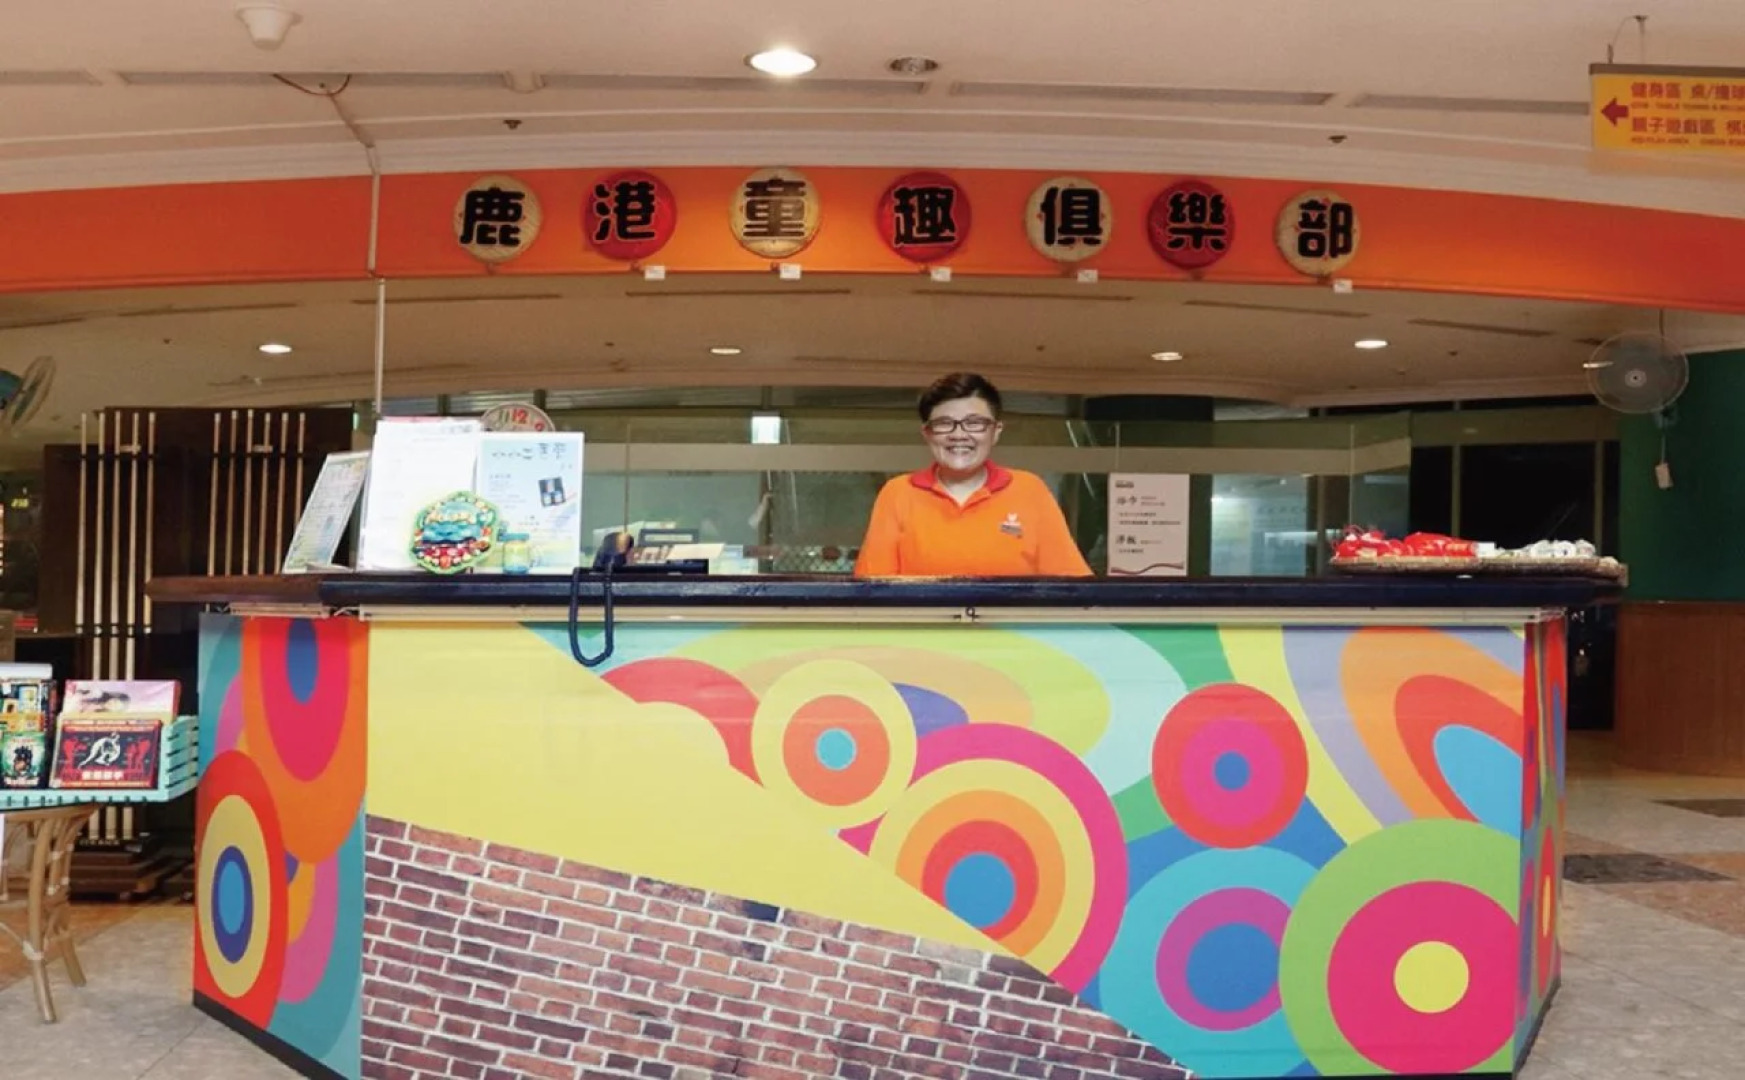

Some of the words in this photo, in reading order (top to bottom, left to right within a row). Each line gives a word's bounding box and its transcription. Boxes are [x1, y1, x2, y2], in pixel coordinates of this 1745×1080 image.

[459, 177, 1355, 259] 鹿港童趣俱樂部
[512, 408, 527, 425] 12
